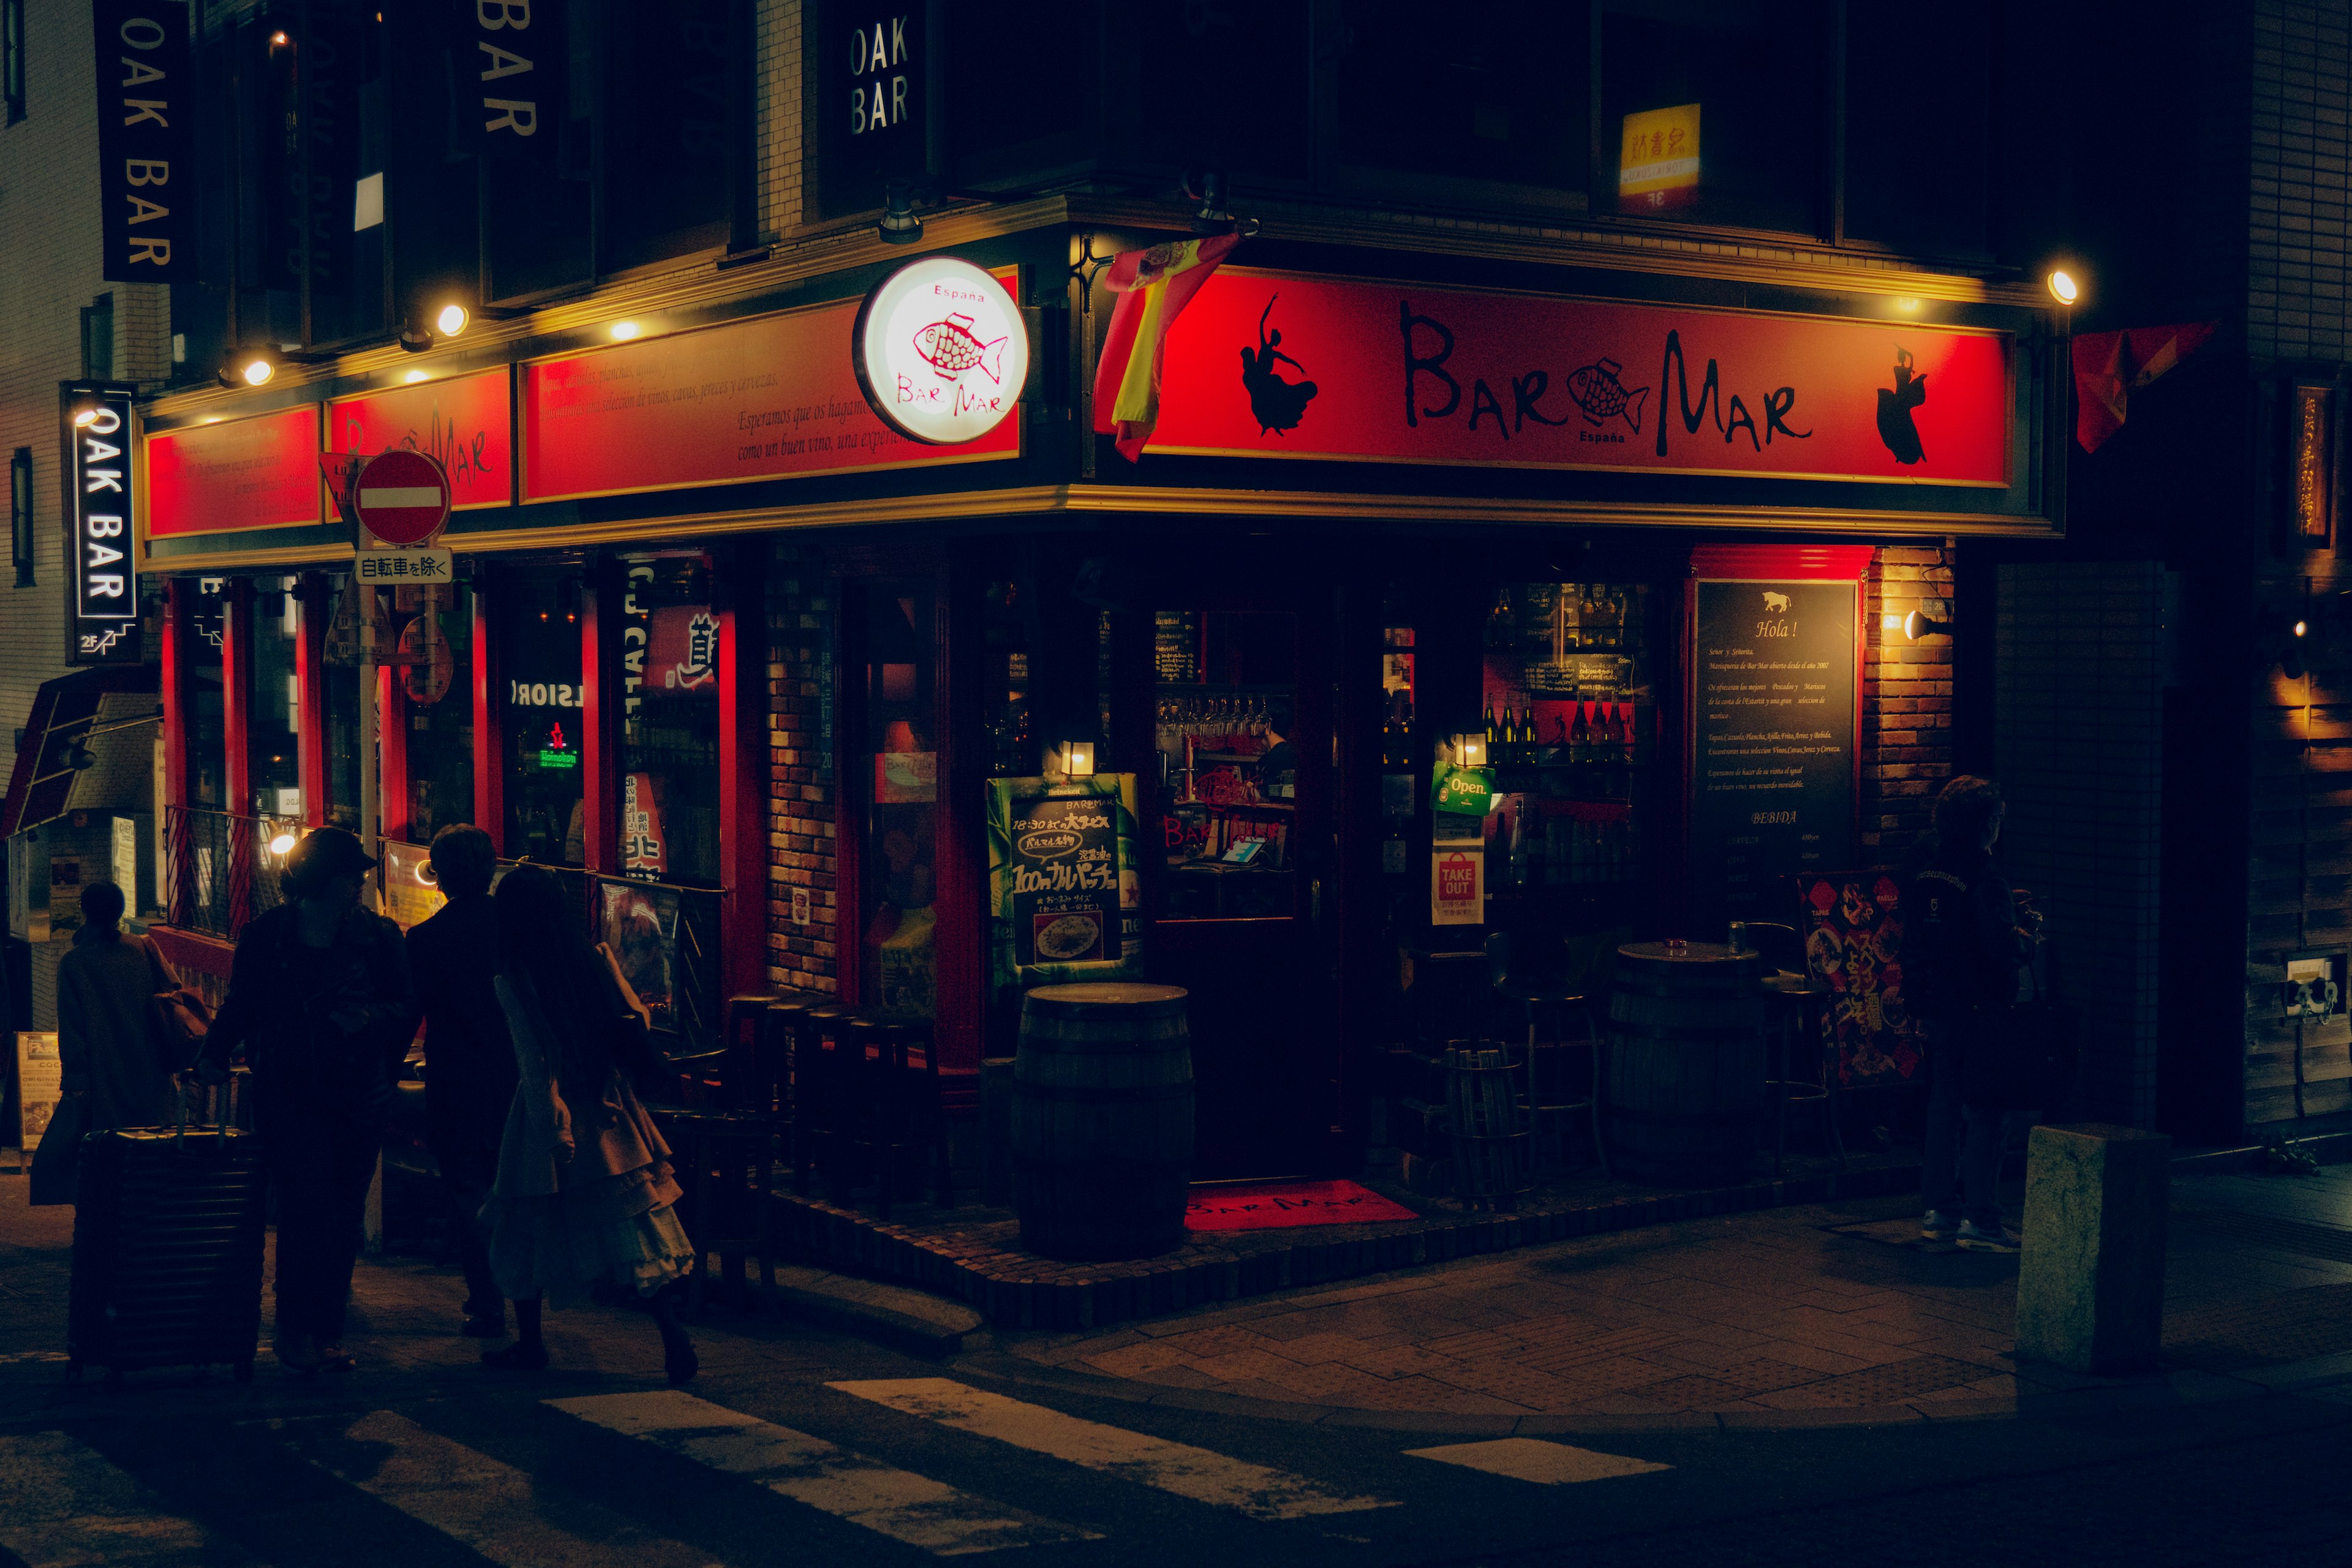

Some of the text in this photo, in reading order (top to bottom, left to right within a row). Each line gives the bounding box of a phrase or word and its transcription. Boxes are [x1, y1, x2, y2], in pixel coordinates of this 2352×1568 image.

[850, 15, 909, 77] OAK
[477, 0, 537, 137] BAR
[851, 75, 909, 136] BAR
[120, 17, 172, 266] OAK BAR
[934, 284, 986, 303] España
[1400, 300, 1812, 457] BAR MAR
[636, 387, 646, 407] de
[897, 372, 1006, 417] BAR MAR
[737, 404, 791, 436] Esperamos
[793, 407, 811, 430] que
[813, 403, 826, 420] os
[738, 444, 763, 461] como
[766, 443, 778, 458] un
[781, 432, 806, 455] buen
[809, 431, 834, 454] vino,
[837, 433, 858, 450] una
[1579, 430, 1626, 445] España
[85, 407, 125, 598] OAK BAR
[361, 557, 448, 578] 自転車を除く
[1755, 619, 1789, 638] Hola
[80, 635, 99, 649] 2F
[1740, 661, 1746, 669] de
[1769, 661, 1787, 669] abierto
[1787, 661, 1801, 669] desde
[1801, 661, 1807, 669] el
[1748, 683, 1766, 692] mejores
[1803, 682, 1826, 690] Mariscos
[822, 752, 832, 769] 20
[1048, 787, 1080, 796] Heineken
[1750, 810, 1798, 826] BEBIDA
[1012, 861, 1118, 894] 100円カルパッチョ
[1442, 869, 1472, 881] TAKE
[1445, 882, 1469, 894] OUT
